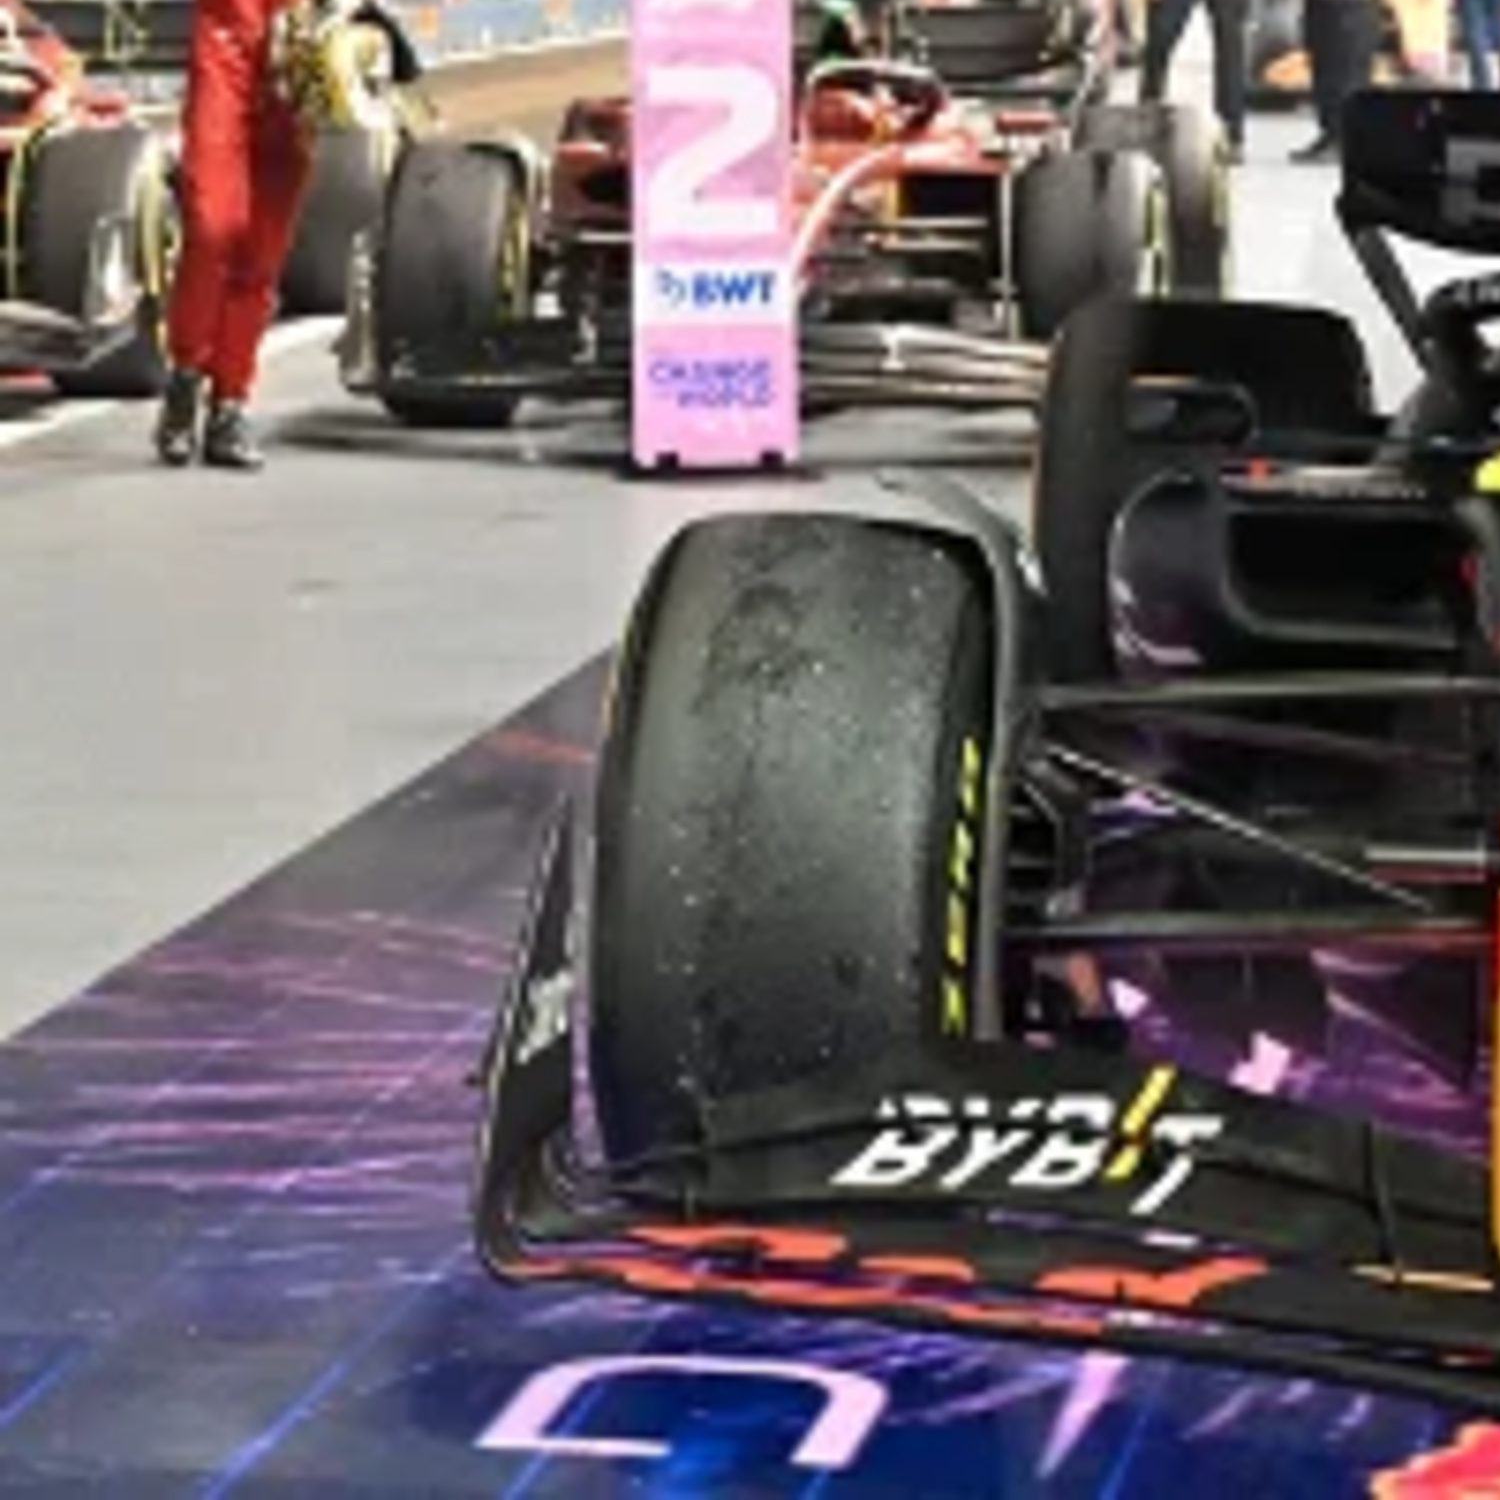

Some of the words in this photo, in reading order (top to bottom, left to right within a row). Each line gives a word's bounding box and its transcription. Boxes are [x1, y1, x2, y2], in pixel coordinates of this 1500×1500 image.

[647, 62, 778, 235] 2
[693, 271, 777, 306] BWT
[828, 1064, 1224, 1216] BYBIT
